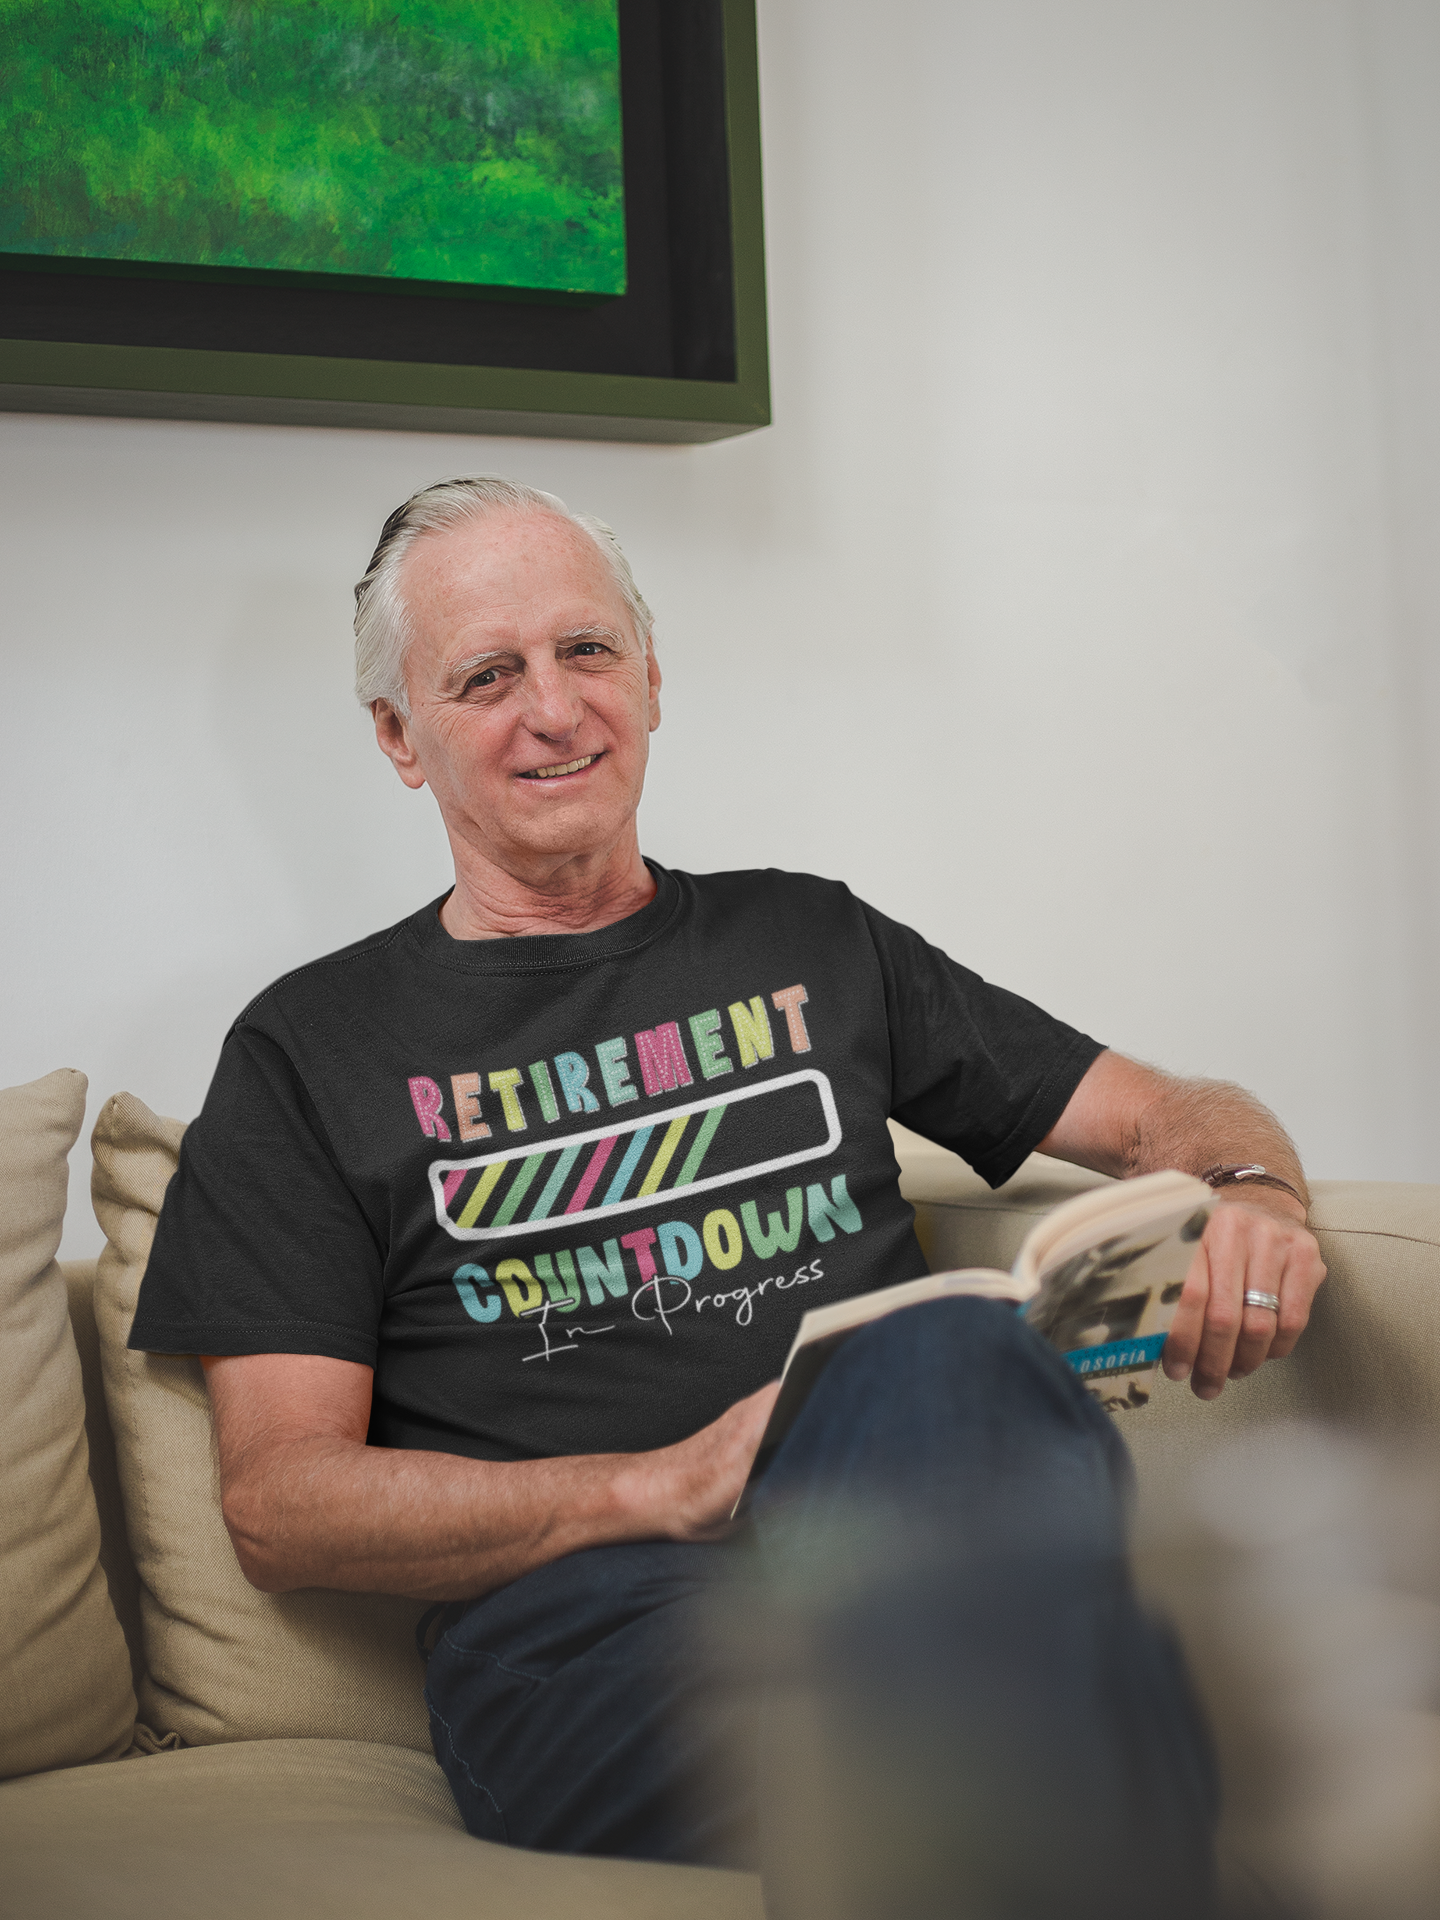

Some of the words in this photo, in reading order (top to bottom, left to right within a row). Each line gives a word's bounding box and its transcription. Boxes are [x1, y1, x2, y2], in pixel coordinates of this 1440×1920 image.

[407, 983, 811, 1142] RETIREMENT
[452, 1174, 863, 1323] COUNTDOWN
[519, 1298, 616, 1362] In
[631, 1258, 825, 1336] Progress
[1071, 1349, 1147, 1373] OSOFÍA
